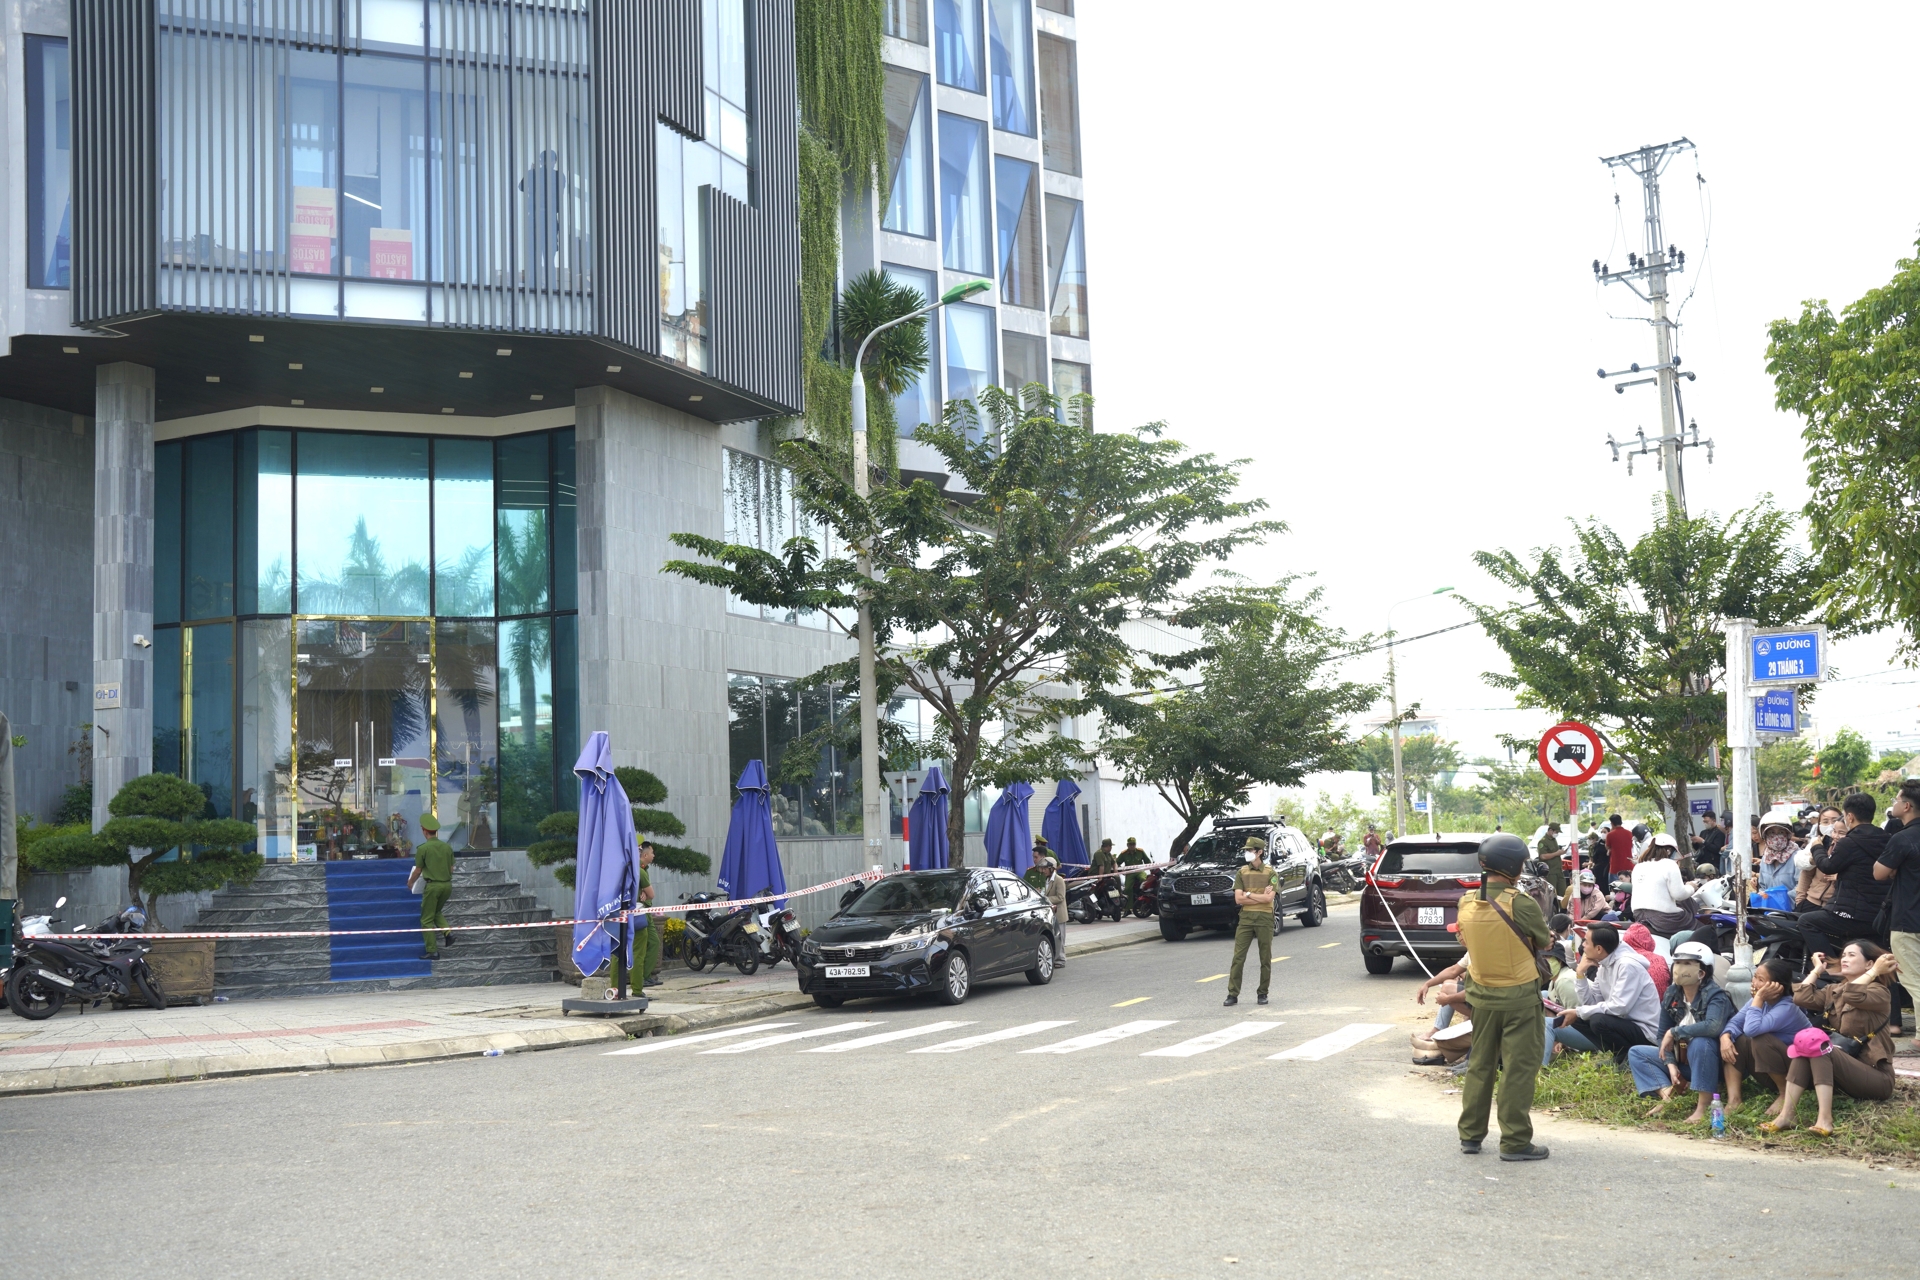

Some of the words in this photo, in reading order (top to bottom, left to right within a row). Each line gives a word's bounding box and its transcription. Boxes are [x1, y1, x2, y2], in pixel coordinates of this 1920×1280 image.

[292, 247, 326, 261] BASTOS
[375, 252, 408, 266] BASTOS
[1775, 638, 1811, 651] ĐƯỜNG
[1768, 661, 1777, 676] 29
[1777, 657, 1798, 675] THÁNG
[1799, 659, 1804, 674] 3
[1767, 694, 1790, 706] ĐƯỜNG
[1756, 709, 1764, 727] LÊ
[1764, 707, 1780, 728] HỒNG
[1780, 712, 1792, 728] SƠN
[1424, 907, 1438, 916] 43A
[1419, 916, 1443, 924] 378.33
